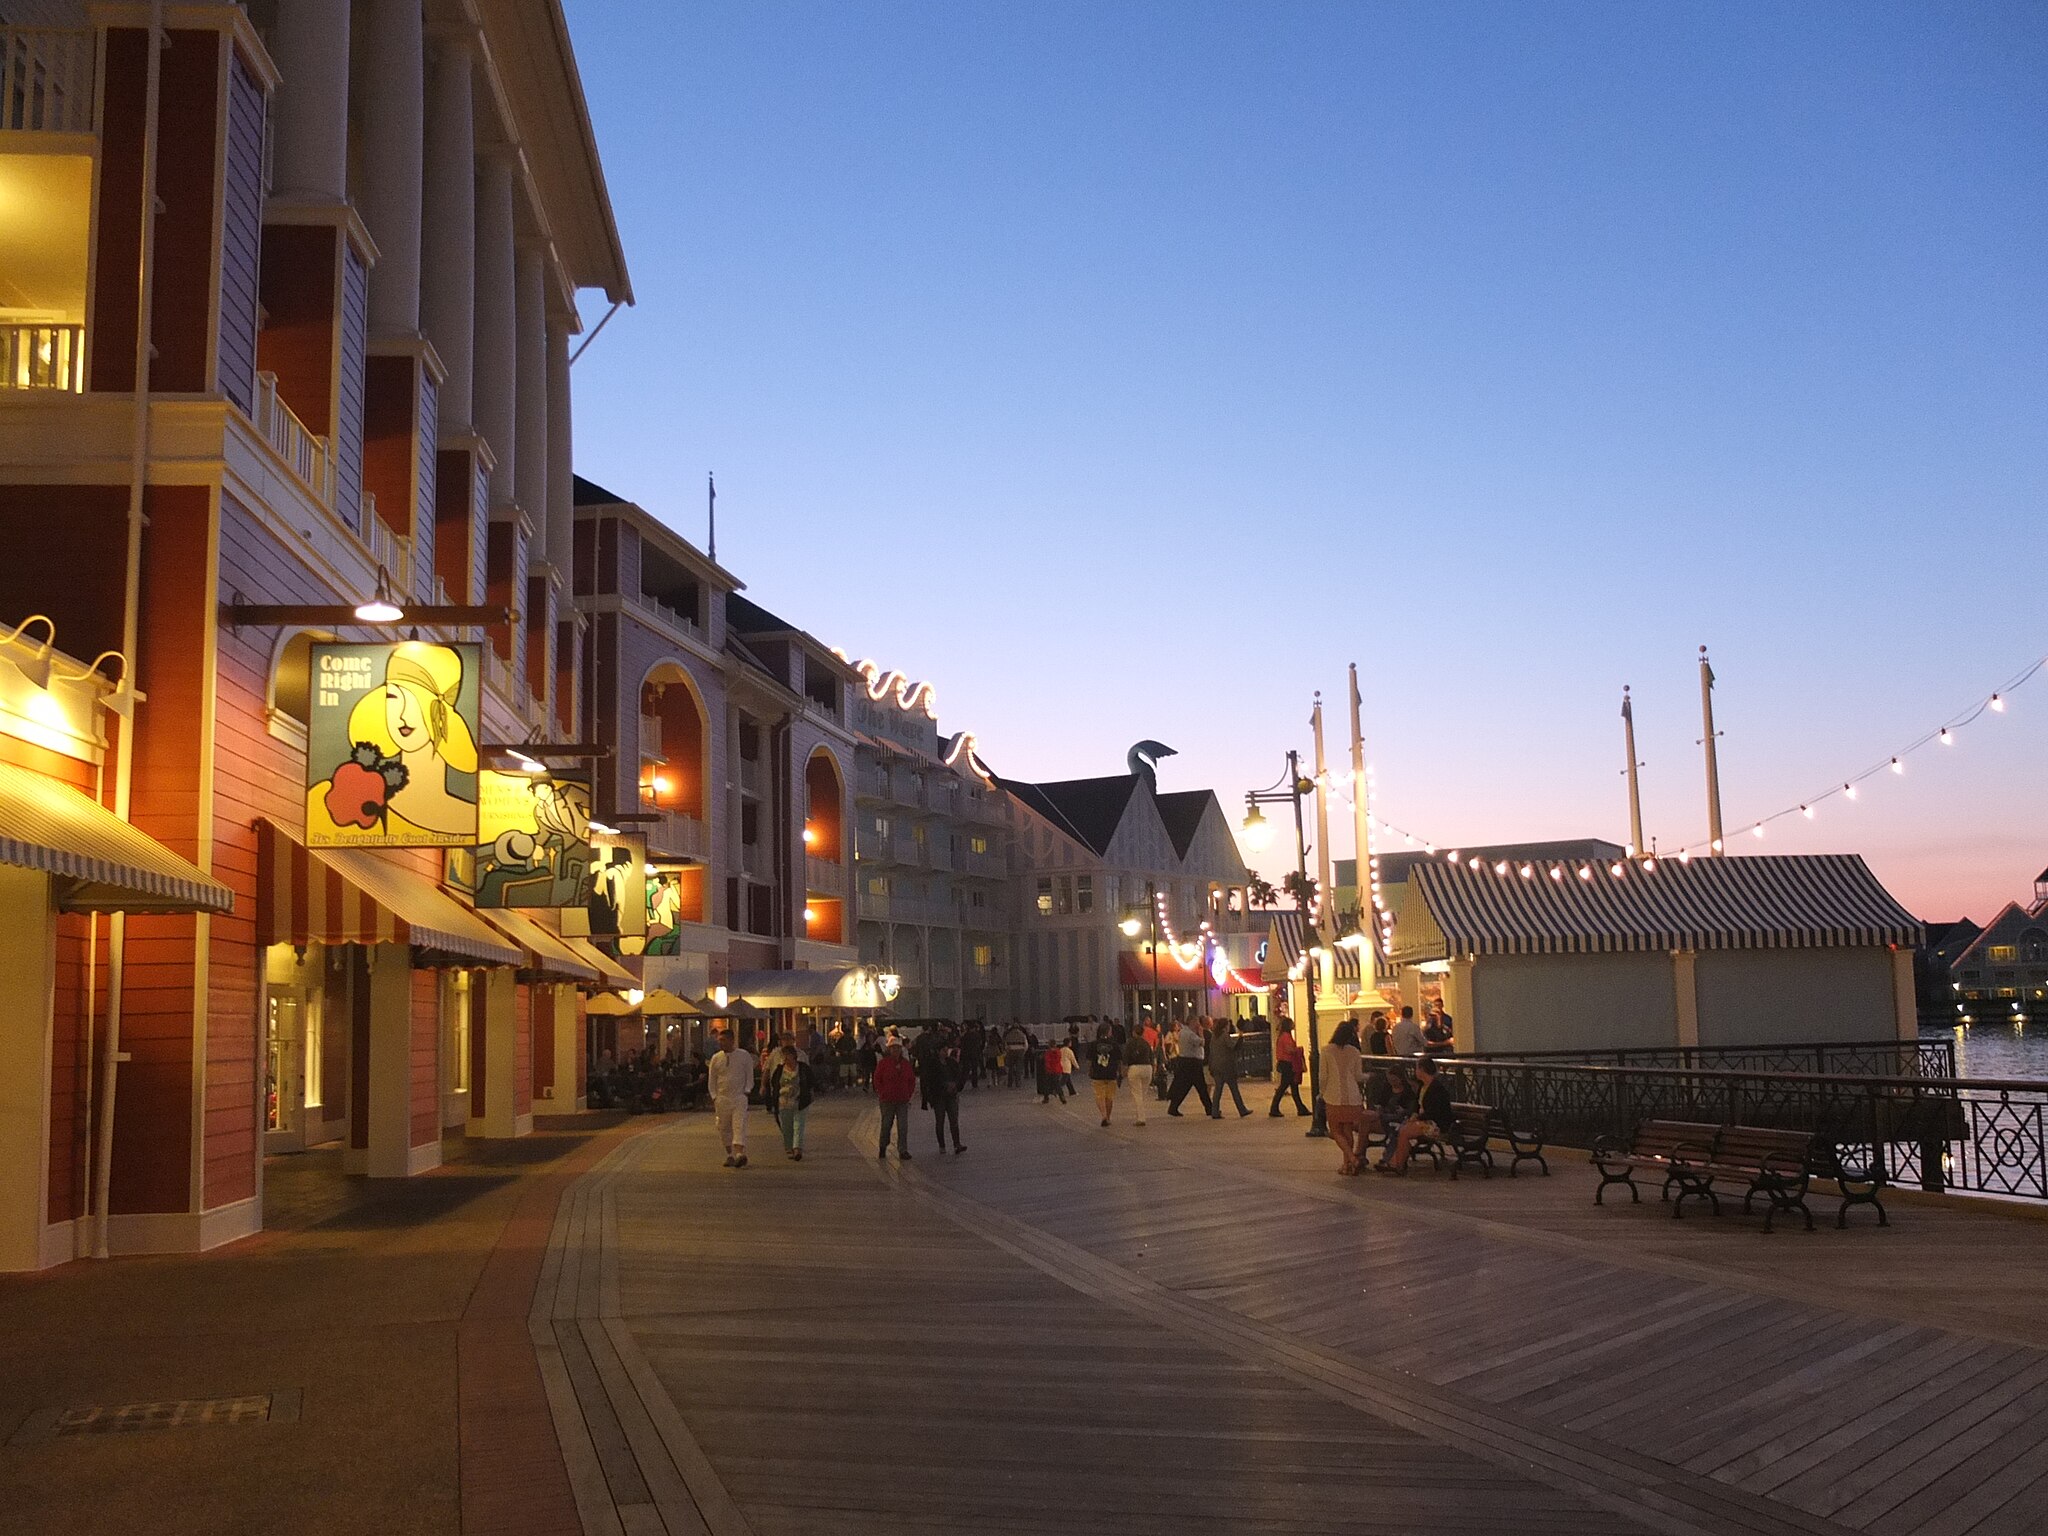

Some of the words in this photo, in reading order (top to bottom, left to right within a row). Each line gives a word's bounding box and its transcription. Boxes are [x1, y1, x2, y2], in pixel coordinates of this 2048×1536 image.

[320, 655, 372, 672] Come
[320, 672, 372, 692] Right
[319, 690, 339, 706] In
